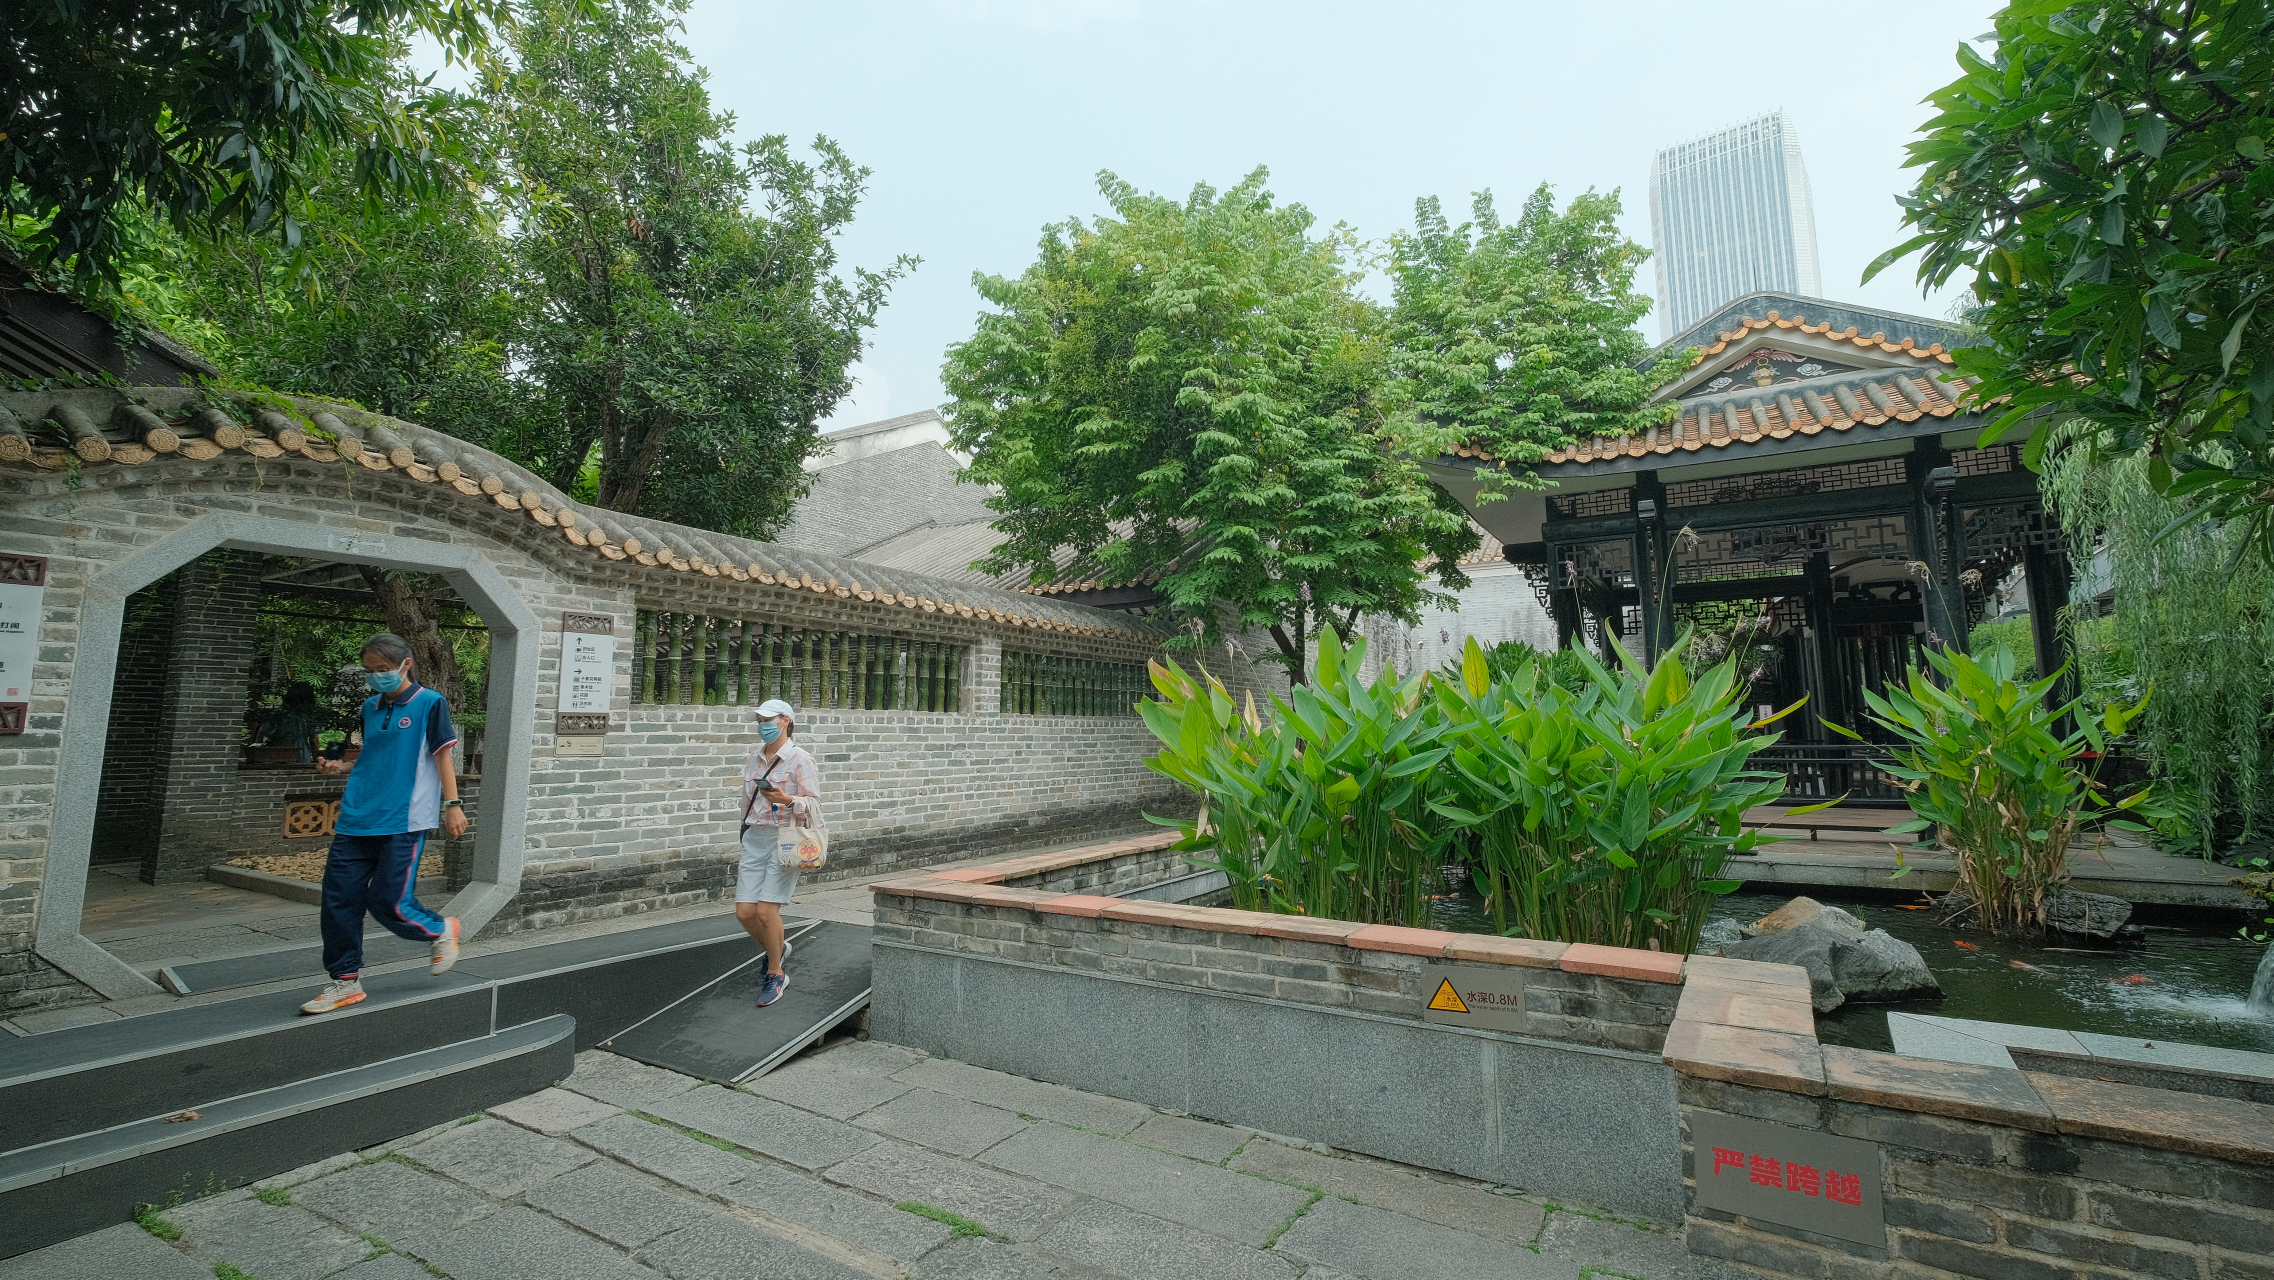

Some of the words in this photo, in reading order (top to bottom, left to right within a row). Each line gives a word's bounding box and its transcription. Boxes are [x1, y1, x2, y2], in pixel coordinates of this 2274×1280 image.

[1467, 991, 1518, 1006] 水深0.8M
[1712, 1147, 1862, 1206] 严禁跨越
